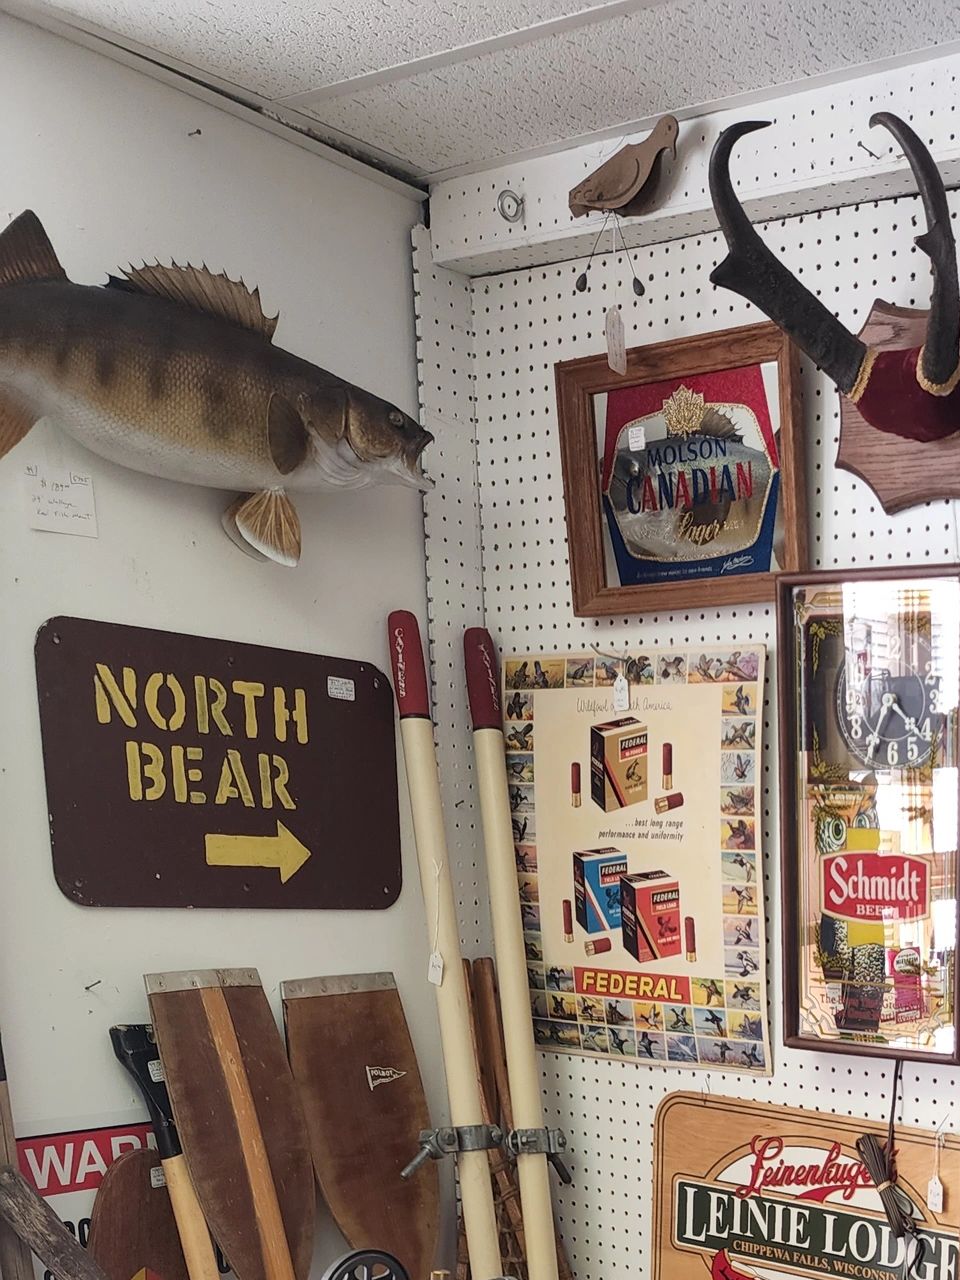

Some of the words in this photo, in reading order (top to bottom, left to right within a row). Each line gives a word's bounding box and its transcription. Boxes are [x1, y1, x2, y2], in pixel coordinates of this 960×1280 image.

[647, 437, 727, 467] MOLSON
[626, 461, 753, 514] CANADIAN
[678, 511, 721, 542] Lager
[94, 662, 309, 745] NORTH
[929, 689, 943, 713] 3
[850, 716, 863, 740] 8
[921, 717, 932, 742] 4
[621, 735, 647, 750] FEDERAL
[887, 742, 899, 765] 6
[907, 736, 919, 761] 5
[125, 740, 297, 810] BEAR
[598, 829, 637, 841] performance
[638, 829, 649, 839] and
[651, 829, 684, 841] uniformity
[650, 818, 664, 830] long
[665, 820, 684, 830] range
[601, 863, 627, 876] FEDERAL
[829, 856, 921, 905] Schmidt
[653, 891, 679, 903] FEDERAL
[667, 901, 677, 909] LOAD
[582, 971, 683, 1000] FEDERAL
[736, 1135, 898, 1201] Leinenkuge
[682, 1186, 811, 1249] LEINIE
[732, 1239, 792, 1264] CHIPPEWA
[793, 1252, 831, 1272] FALLS,
